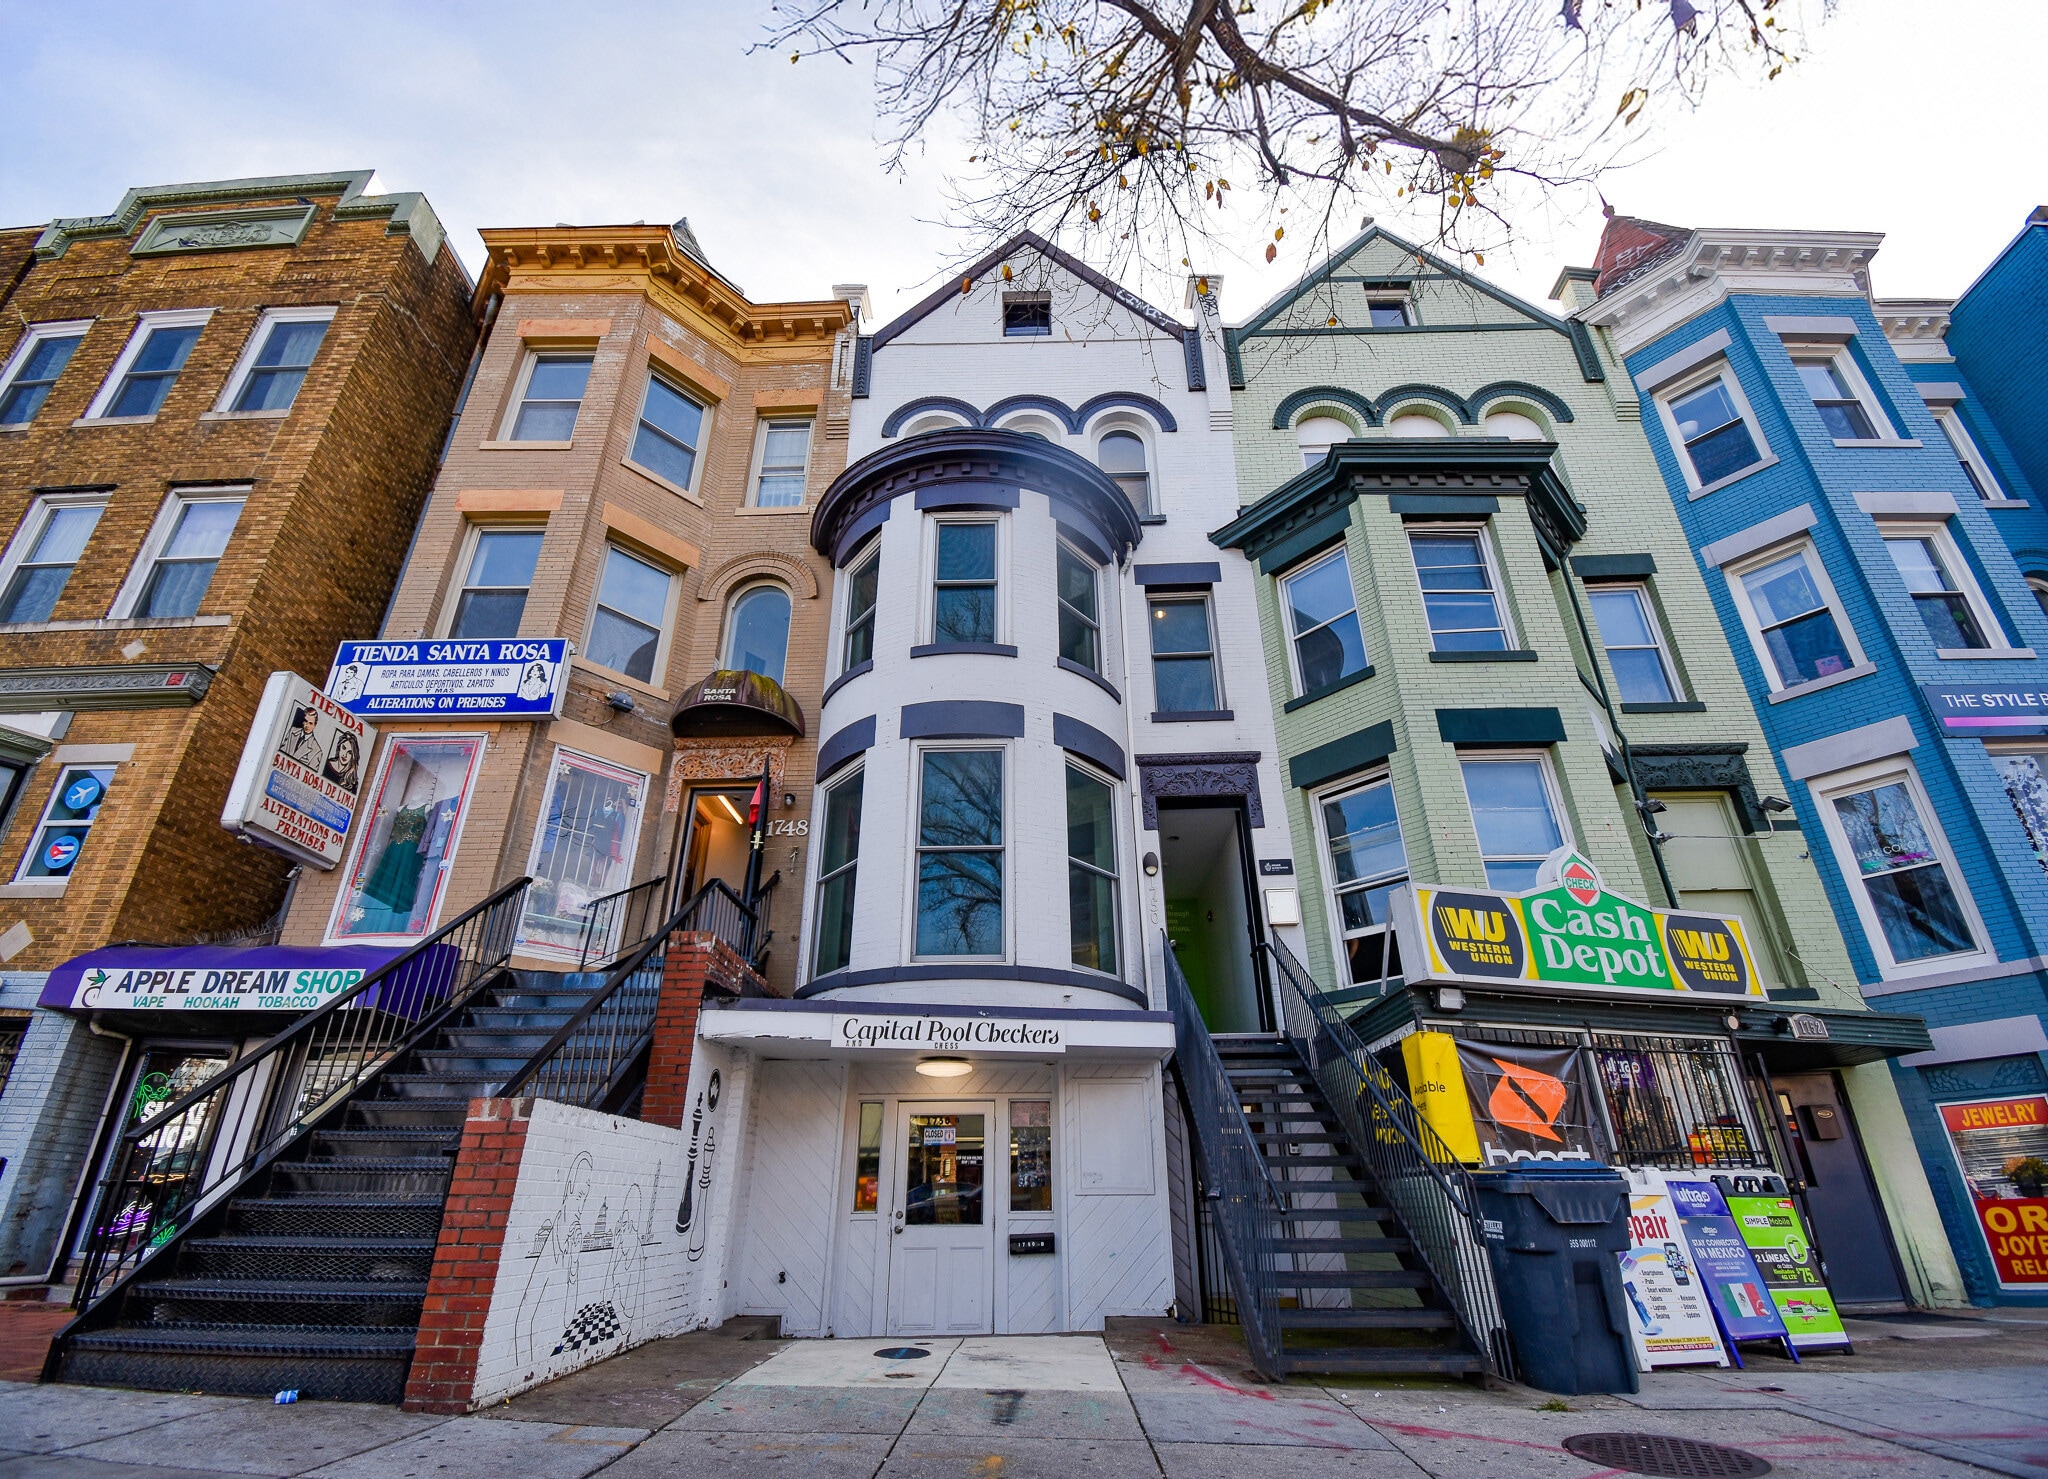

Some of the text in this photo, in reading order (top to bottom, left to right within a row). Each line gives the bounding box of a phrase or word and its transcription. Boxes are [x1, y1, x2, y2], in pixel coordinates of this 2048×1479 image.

[352, 643, 551, 662] TIENDA SANTA ROSA
[381, 669, 397, 678] ROPA
[399, 669, 415, 678] PARA
[484, 668, 490, 677] Y
[390, 680, 424, 689] ARTICULOS
[466, 679, 495, 688] ZAPATOS
[366, 696, 506, 709] ALTERATIONS ON PREMISES
[1941, 694, 1980, 708] THE
[1982, 693, 2040, 707] STYLE
[310, 689, 364, 737] TIENDA
[272, 753, 302, 780] SANTA
[302, 769, 324, 793] ROSA
[325, 782, 337, 798] DE
[336, 788, 355, 810] LIMA
[260, 797, 344, 848] ALTERATIONS ON
[766, 819, 808, 836] 1748
[275, 819, 326, 852] PREMISES
[1856, 848, 1880, 860] LUX
[1565, 876, 1596, 890] CHECK
[1440, 906, 1506, 942] WU
[1530, 898, 1652, 942] Cash
[1448, 940, 1511, 954] WESTERN
[1673, 929, 1730, 962] WU
[1470, 952, 1514, 964] UNION
[1538, 933, 1666, 984] Depot
[1684, 960, 1736, 972] WESTERN
[114, 970, 361, 994] APPLE DREAM SHOP
[1702, 971, 1738, 982] UNION
[132, 996, 318, 1009] VAPE HOOKAH TOBACCO
[842, 1018, 1060, 1046] Capital Pool Checkers
[934, 1042, 959, 1050] CHESS
[1962, 1103, 2037, 1127] JEWELRY
[924, 1130, 944, 1138] CLOSED
[1744, 1217, 1790, 1226] SIMPLE Mobile
[1706, 1238, 1740, 1246] CONNECTED
[1696, 1248, 1746, 1258] IN MEXICO
[1755, 1252, 1790, 1262] 2 LÍNEAS
